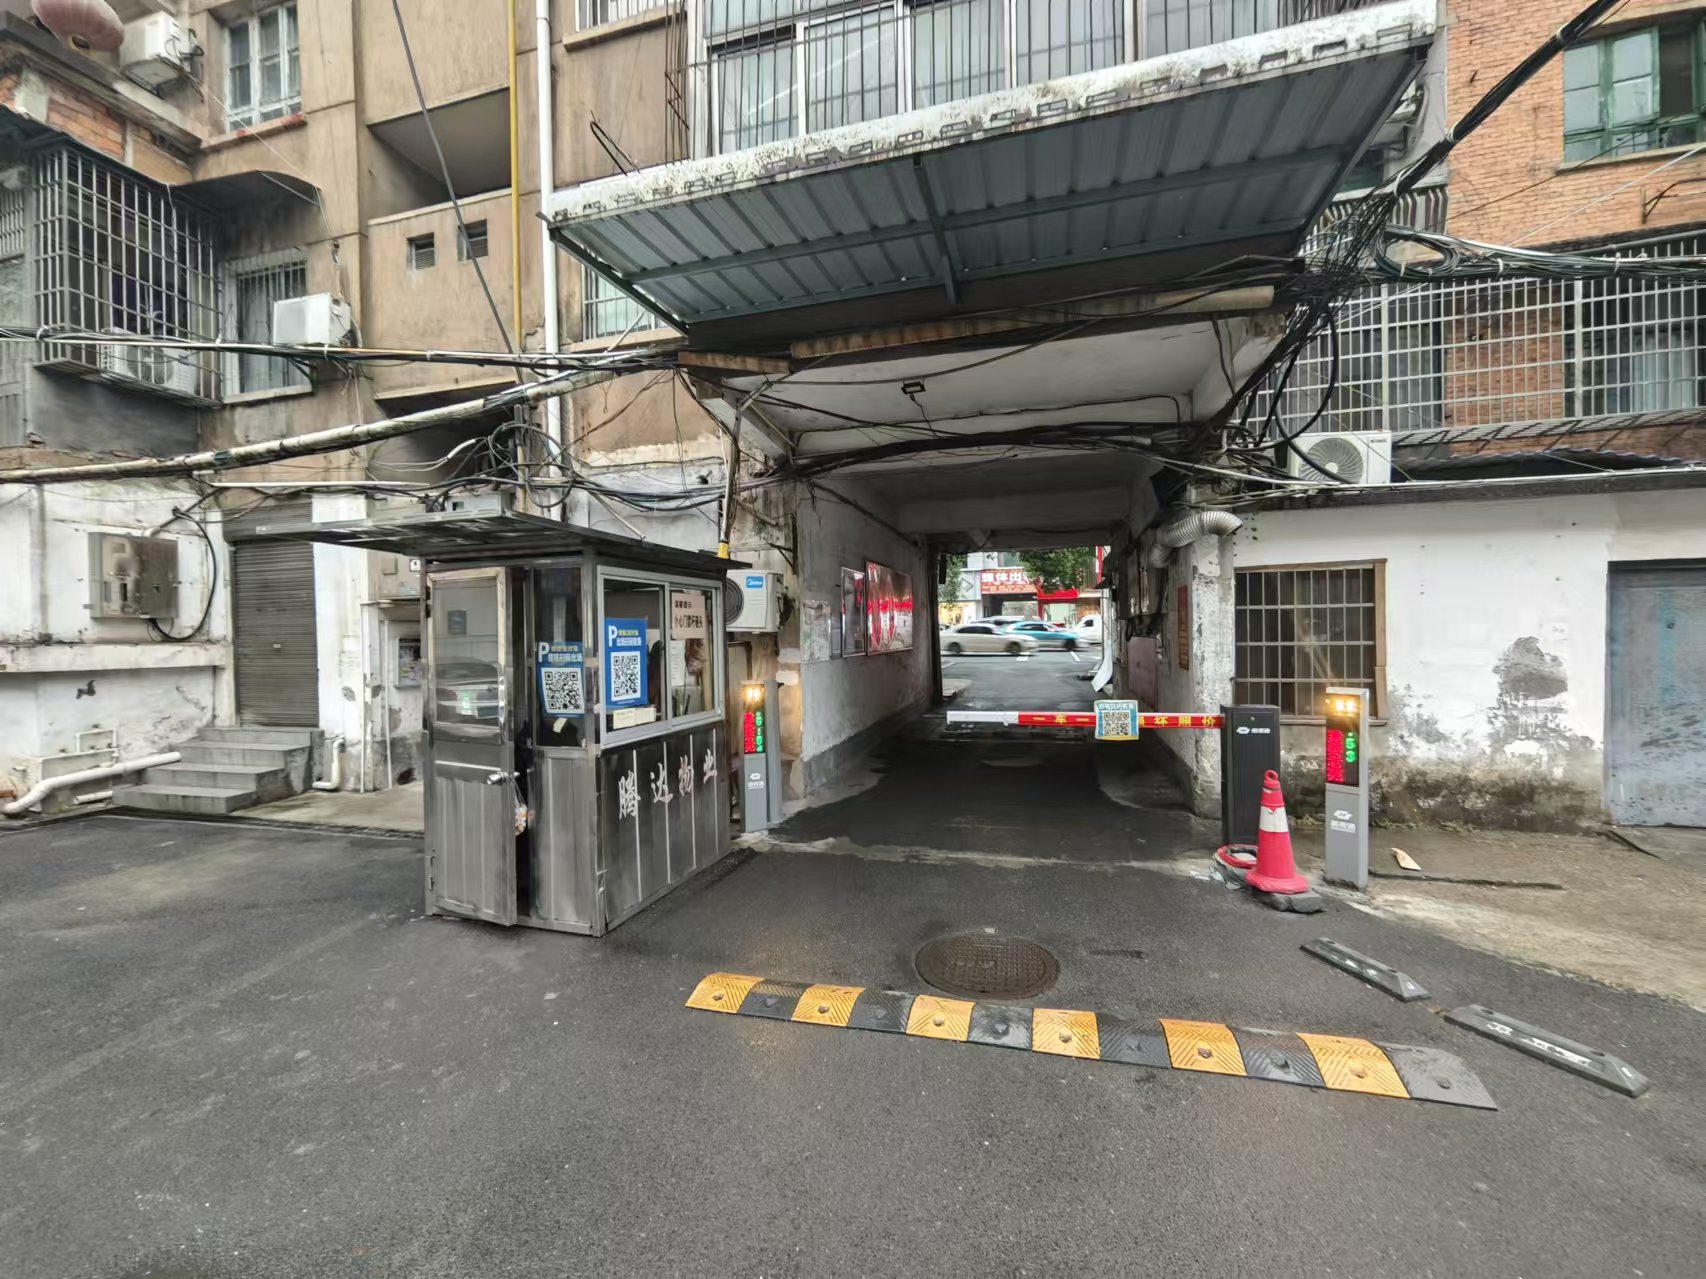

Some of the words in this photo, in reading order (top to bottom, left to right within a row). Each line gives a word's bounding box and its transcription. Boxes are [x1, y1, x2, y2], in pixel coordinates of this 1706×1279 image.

[607, 625, 618, 648] P
[538, 641, 550, 663] P
[618, 747, 718, 820] 腾达物业
